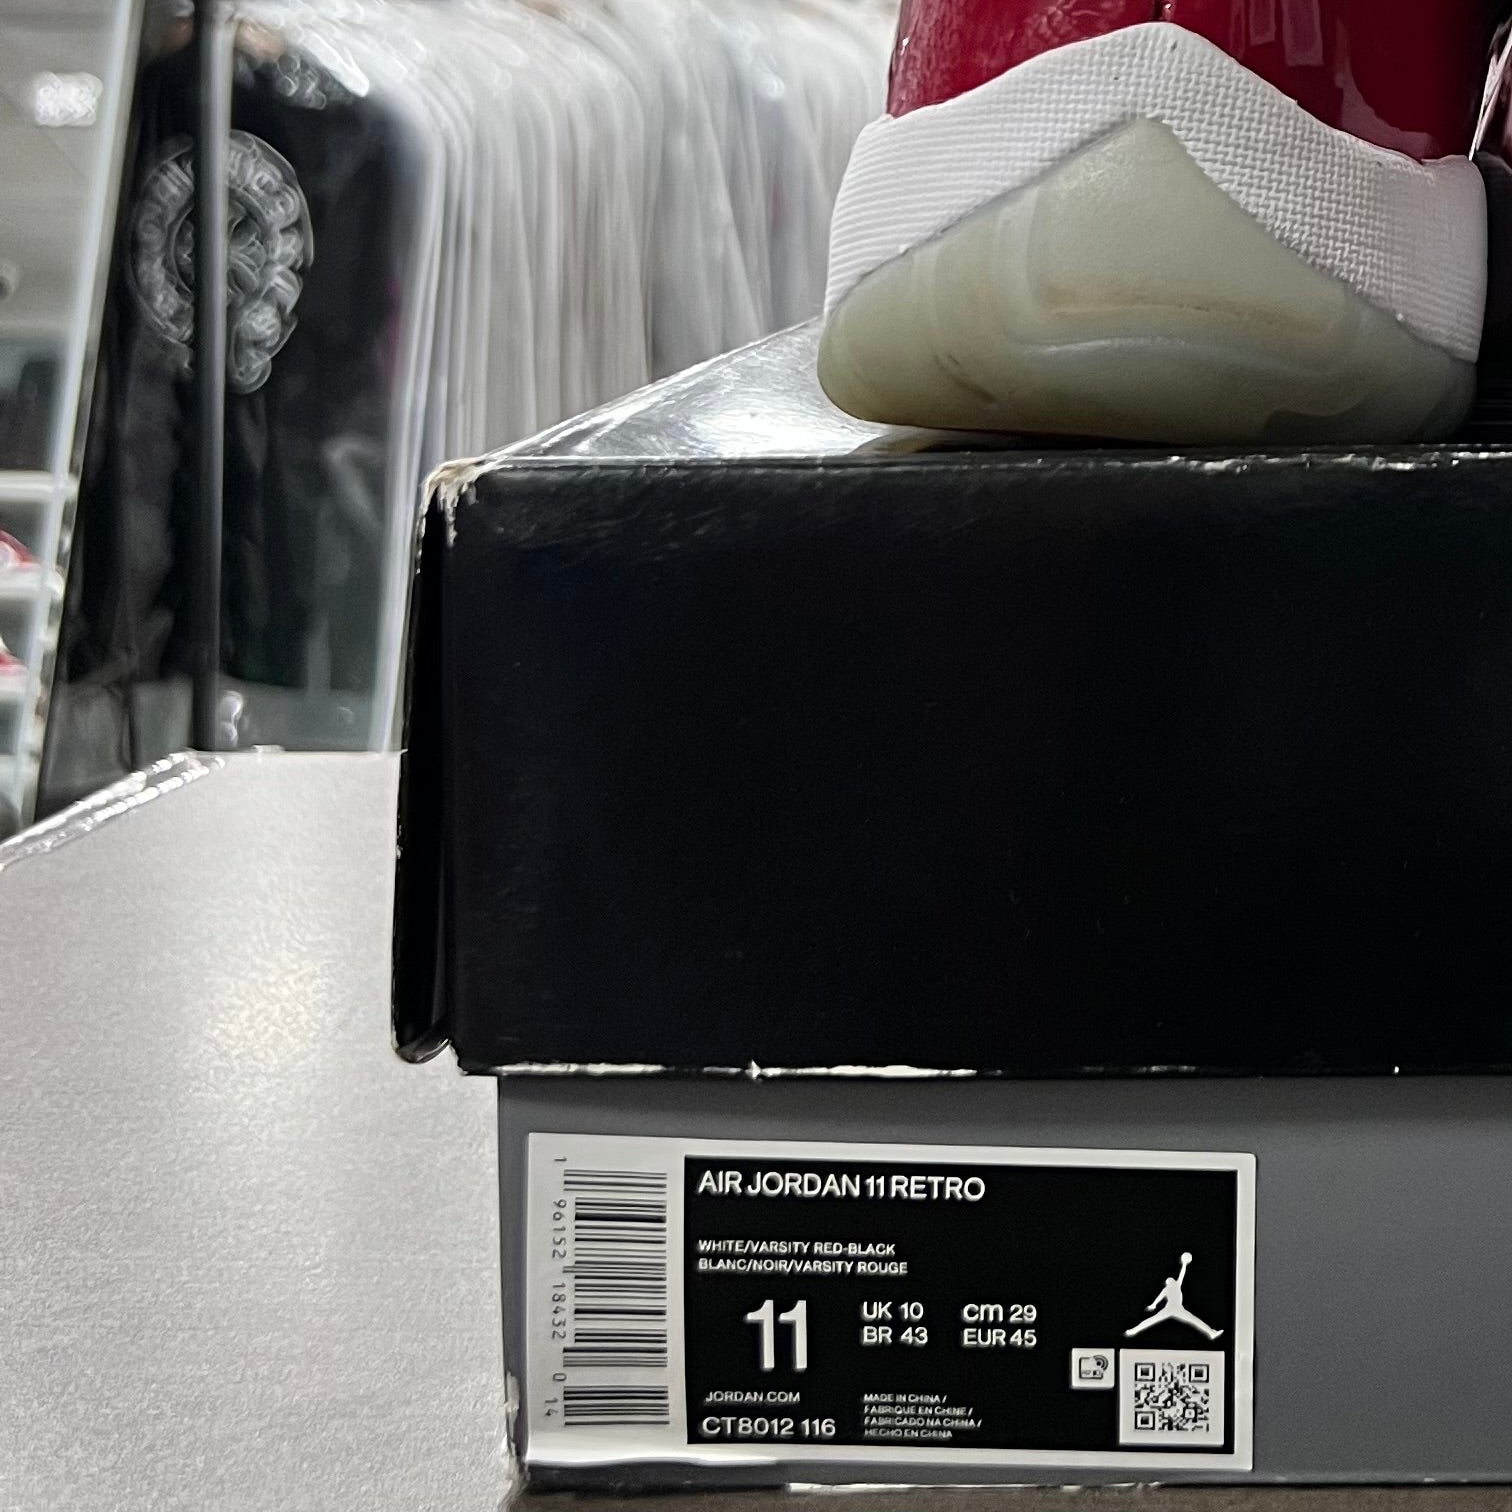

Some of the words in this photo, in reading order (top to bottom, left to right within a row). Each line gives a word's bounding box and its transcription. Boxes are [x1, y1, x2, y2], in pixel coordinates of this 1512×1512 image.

[698, 1170, 743, 1196] AIR
[747, 1171, 861, 1198] JORDAN
[865, 1175, 886, 1198] 11
[890, 1176, 986, 1202] RETRO
[552, 1199, 567, 1260] 96152
[698, 1239, 811, 1255] WHITE/VARSITY
[813, 1242, 896, 1257] RED-BLACK
[698, 1258, 854, 1274] BLANC/NOIR/VARSITY
[857, 1262, 908, 1275] ROUGE
[551, 1282, 567, 1340] 18432
[861, 1301, 893, 1321] UK
[899, 1301, 924, 1321] 10
[1008, 1304, 1037, 1323] 29
[745, 1299, 808, 1371] 11
[861, 1326, 893, 1345] BR
[899, 1326, 929, 1346] 43
[961, 1328, 1006, 1347] EUR
[1008, 1328, 1037, 1347] 45
[704, 1391, 801, 1404] JORDAN.COM
[863, 1393, 894, 1403] MADE
[918, 1405, 933, 1415] EN
[701, 1417, 795, 1437] CT8012
[800, 1418, 836, 1437] 116
[926, 1417, 941, 1427] NA
